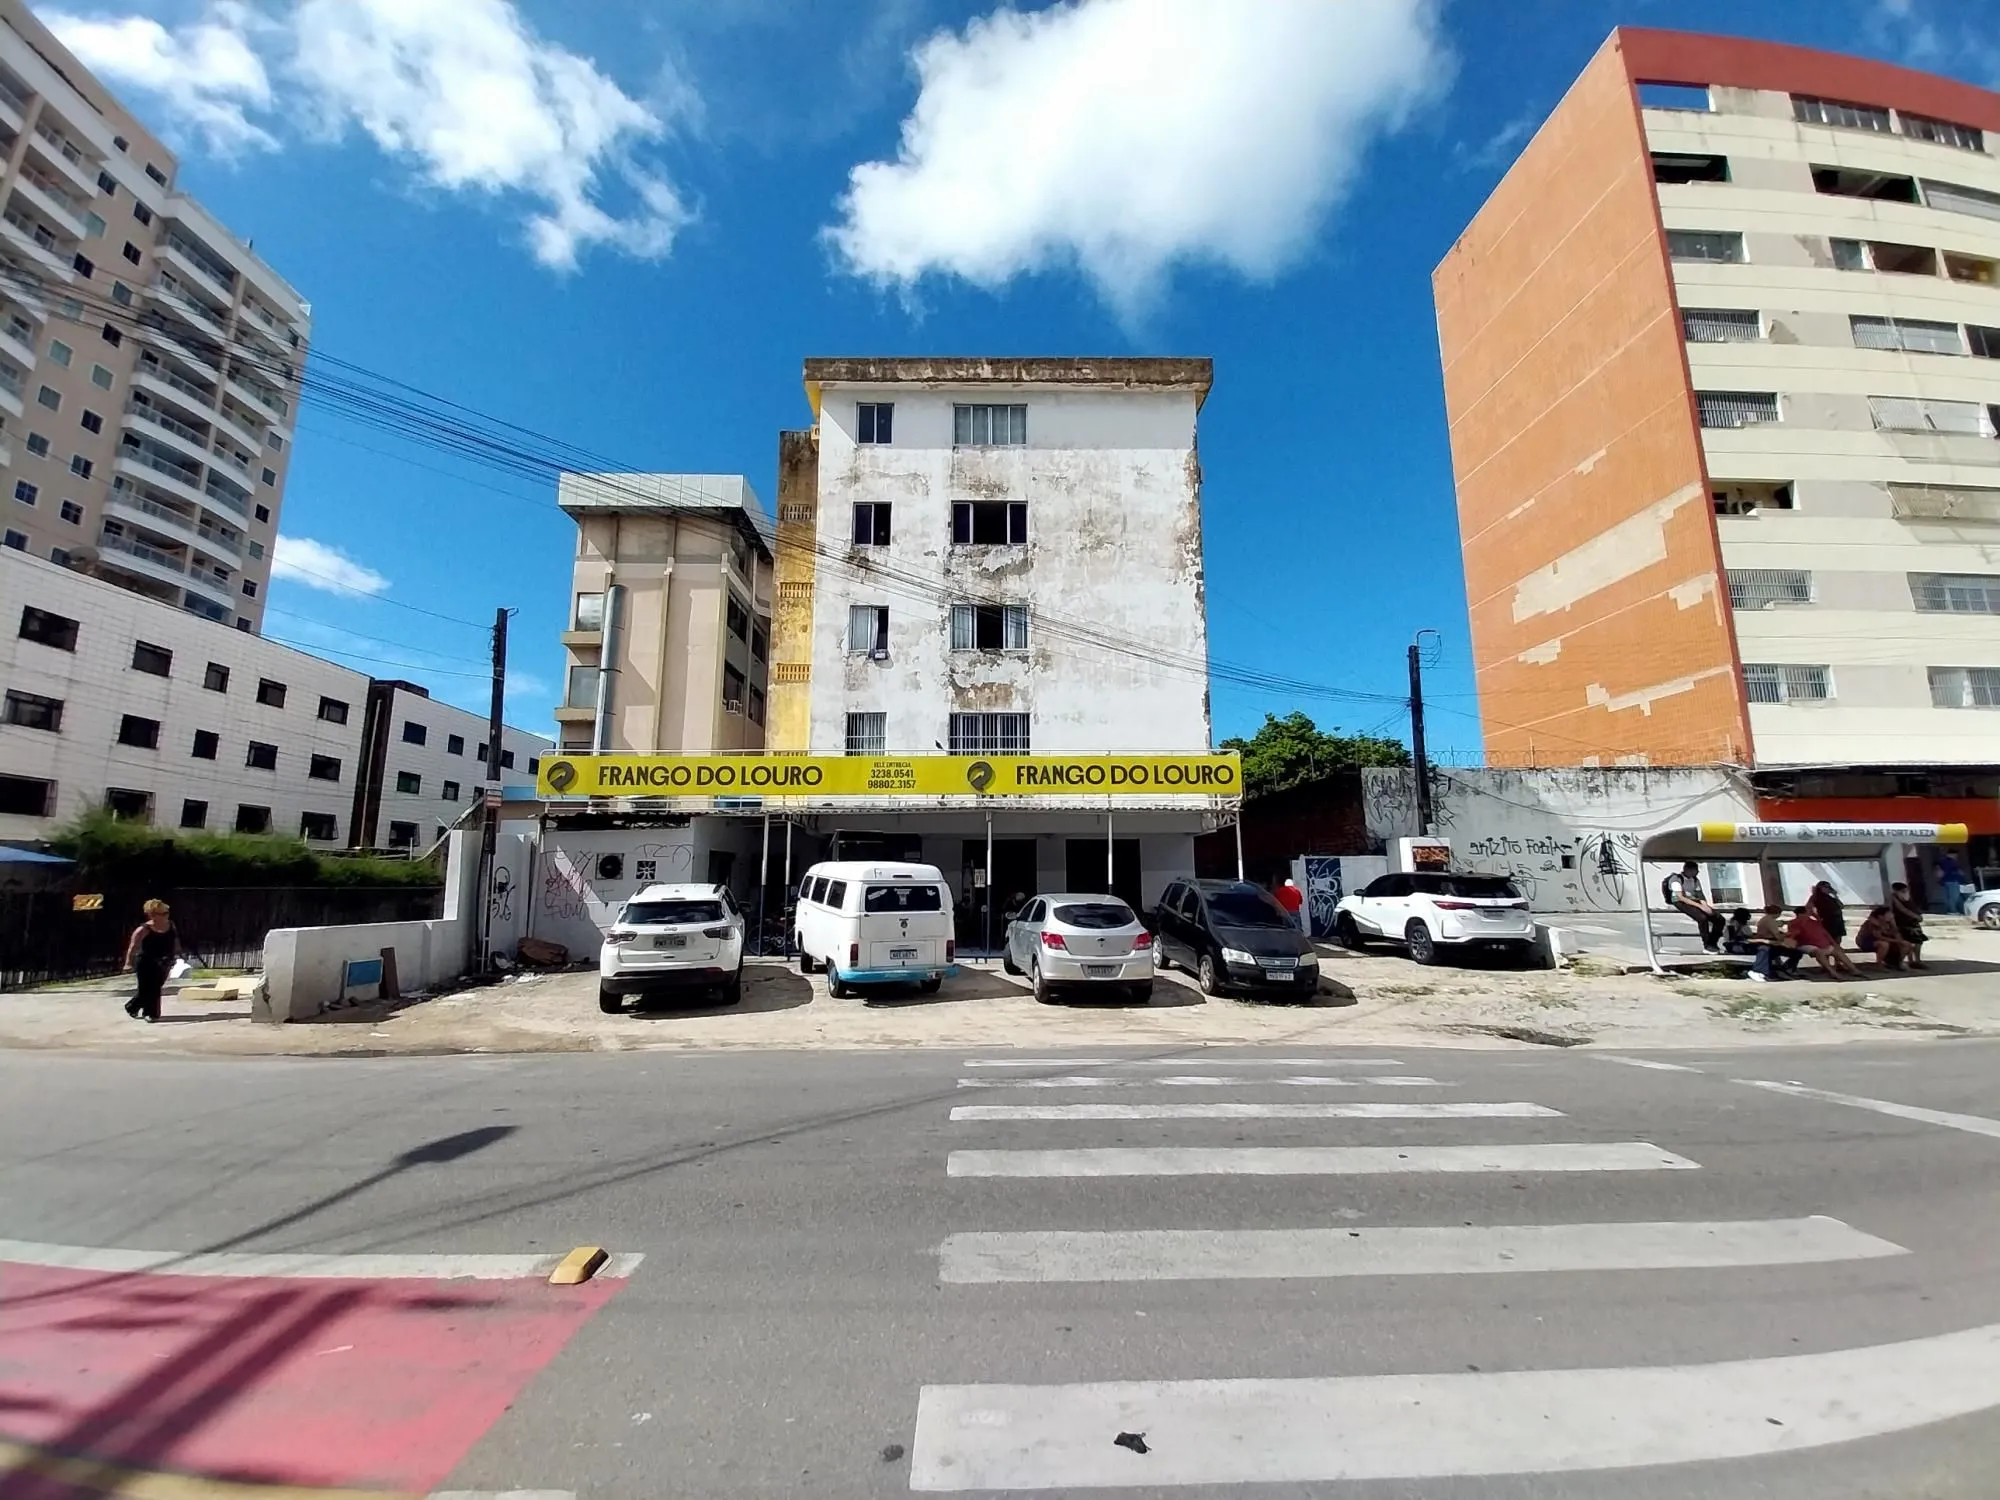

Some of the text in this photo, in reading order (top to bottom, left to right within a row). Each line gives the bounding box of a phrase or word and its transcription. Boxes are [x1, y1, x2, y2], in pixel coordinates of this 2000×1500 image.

[598, 765, 823, 786] FRANGO DO LOURO
[870, 769, 914, 778] 3238.0541
[1016, 765, 1235, 785] FRANGO DO LOURO
[867, 779, 916, 789] 98802.3157
[1748, 826, 1787, 836] ETUFOR
[1817, 828, 1936, 838] PREFEITURA DE FORTALEZA
